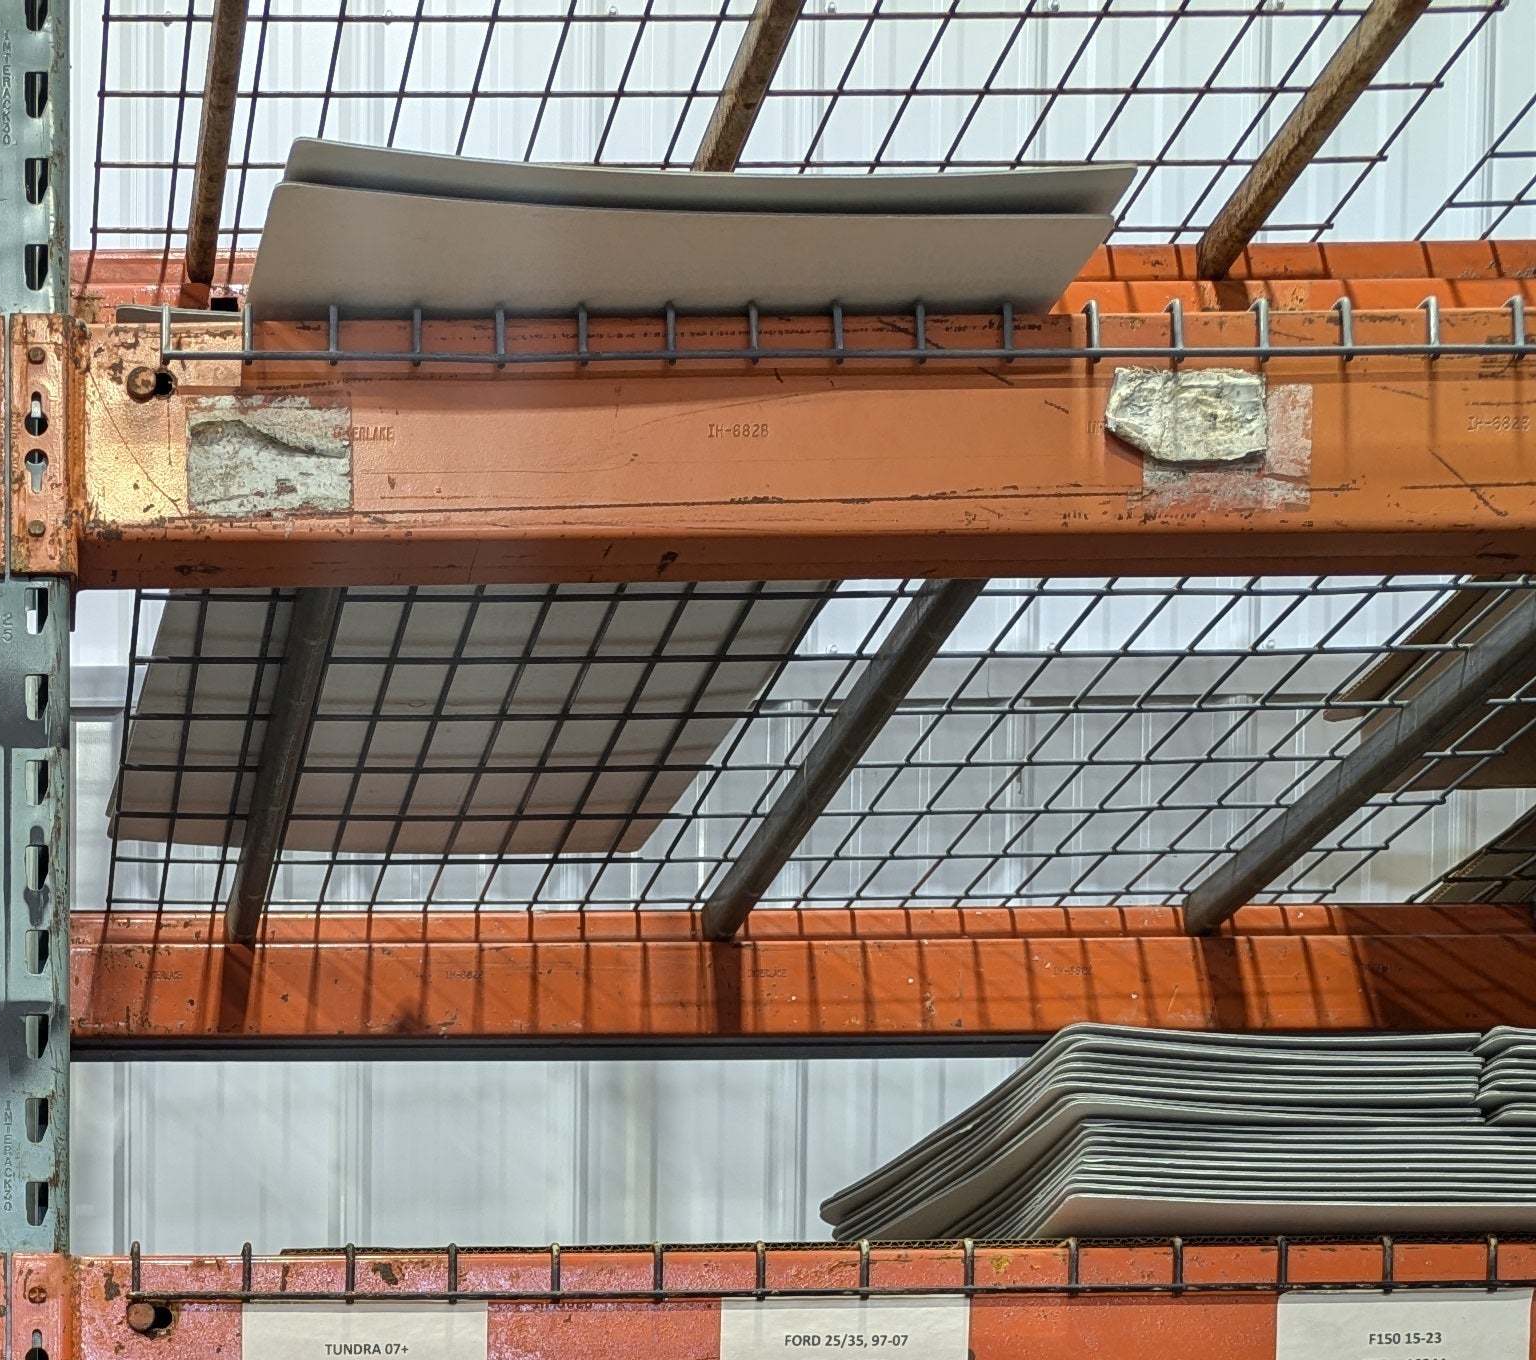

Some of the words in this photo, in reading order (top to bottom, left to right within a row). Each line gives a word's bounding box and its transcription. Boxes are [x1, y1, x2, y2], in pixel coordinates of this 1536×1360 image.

[784, 1334, 822, 1347] FORD
[824, 1333, 868, 1349] 25/35,
[871, 1334, 909, 1347] 97-07
[1368, 1332, 1401, 1345] F150
[1404, 1331, 1442, 1345] 15-23
[324, 1343, 382, 1356] TUNDRA
[384, 1343, 409, 1355] 07+
